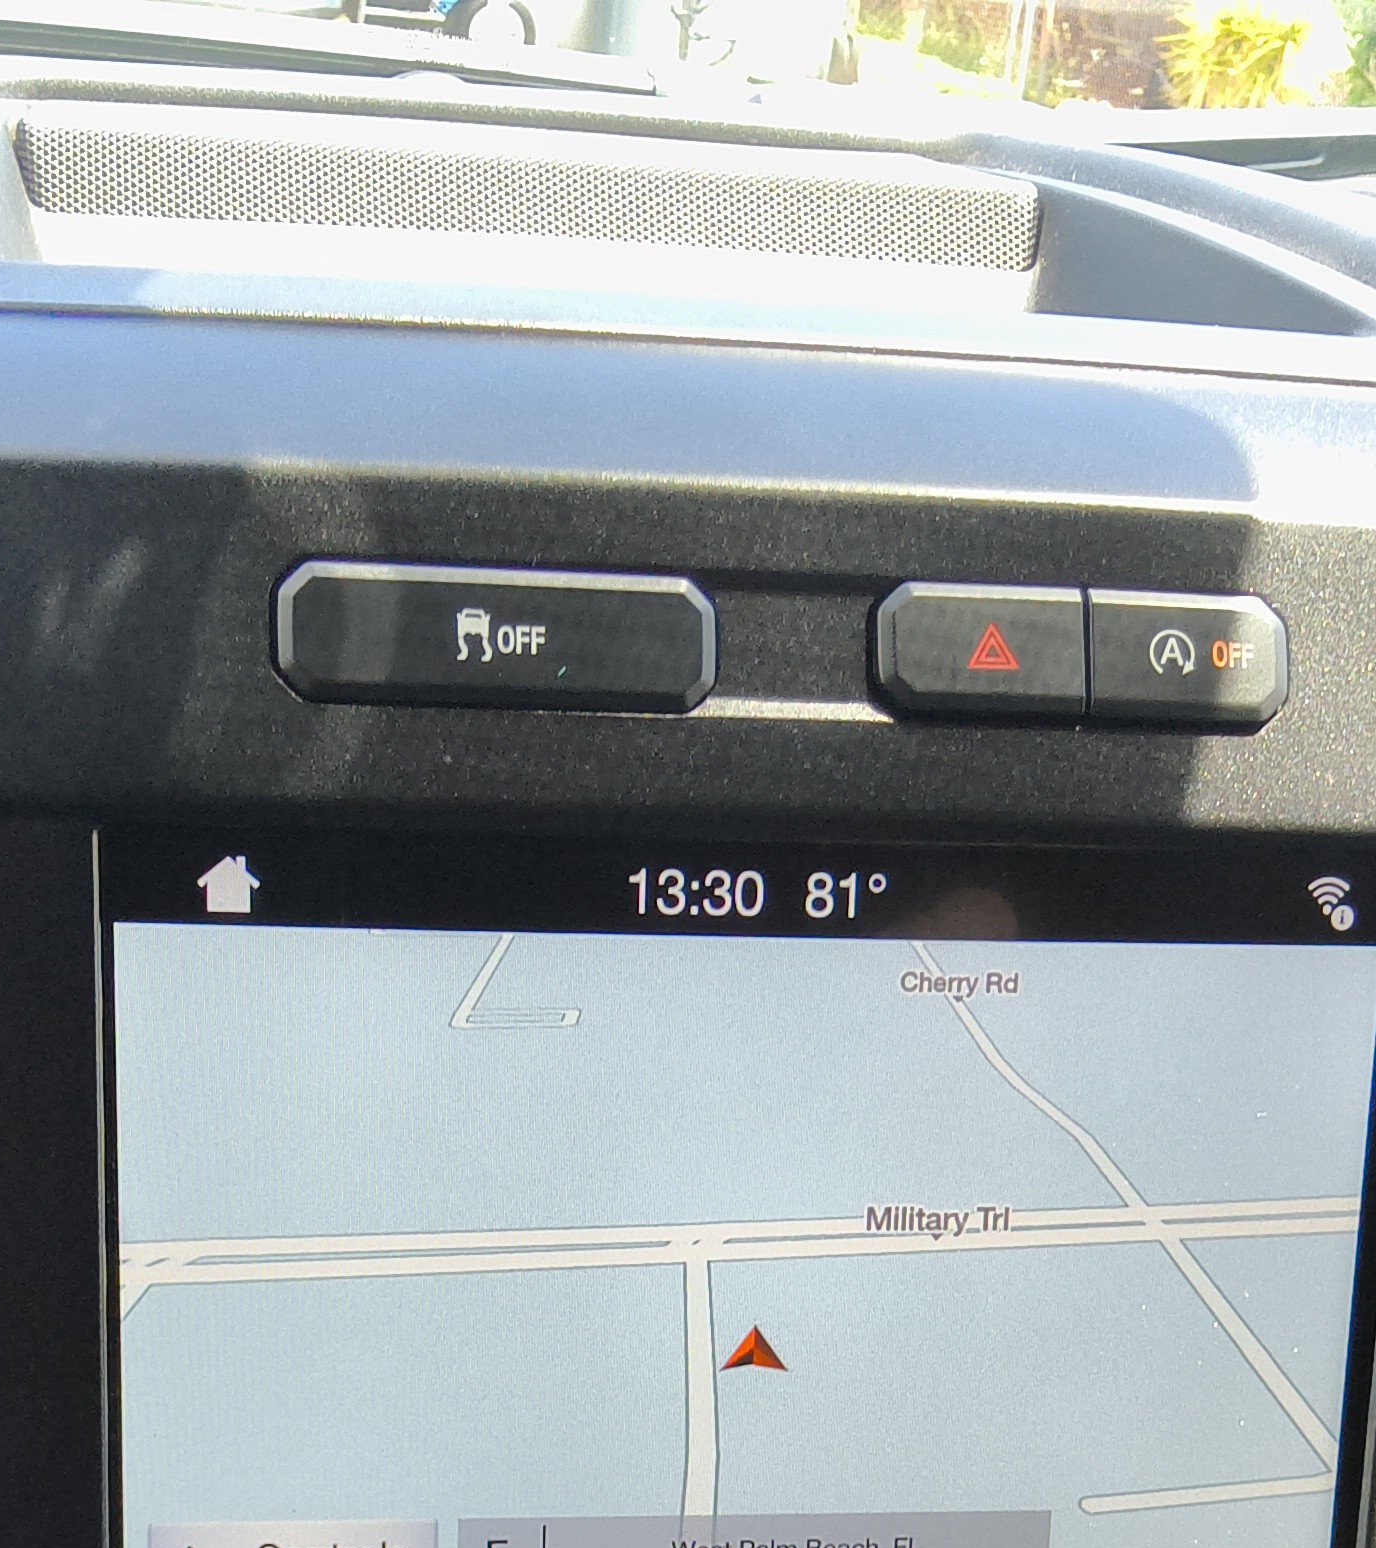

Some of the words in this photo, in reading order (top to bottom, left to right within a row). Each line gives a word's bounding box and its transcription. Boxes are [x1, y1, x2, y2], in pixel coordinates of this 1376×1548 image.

[497, 625, 546, 656] OFF
[1212, 640, 1255, 670] OFF
[628, 867, 765, 917] 13:30
[805, 871, 888, 919] 81°
[900, 971, 979, 998] Cherry
[986, 972, 1019, 994] Rd
[865, 1206, 970, 1238] Military
[976, 1206, 1010, 1232] Trl
